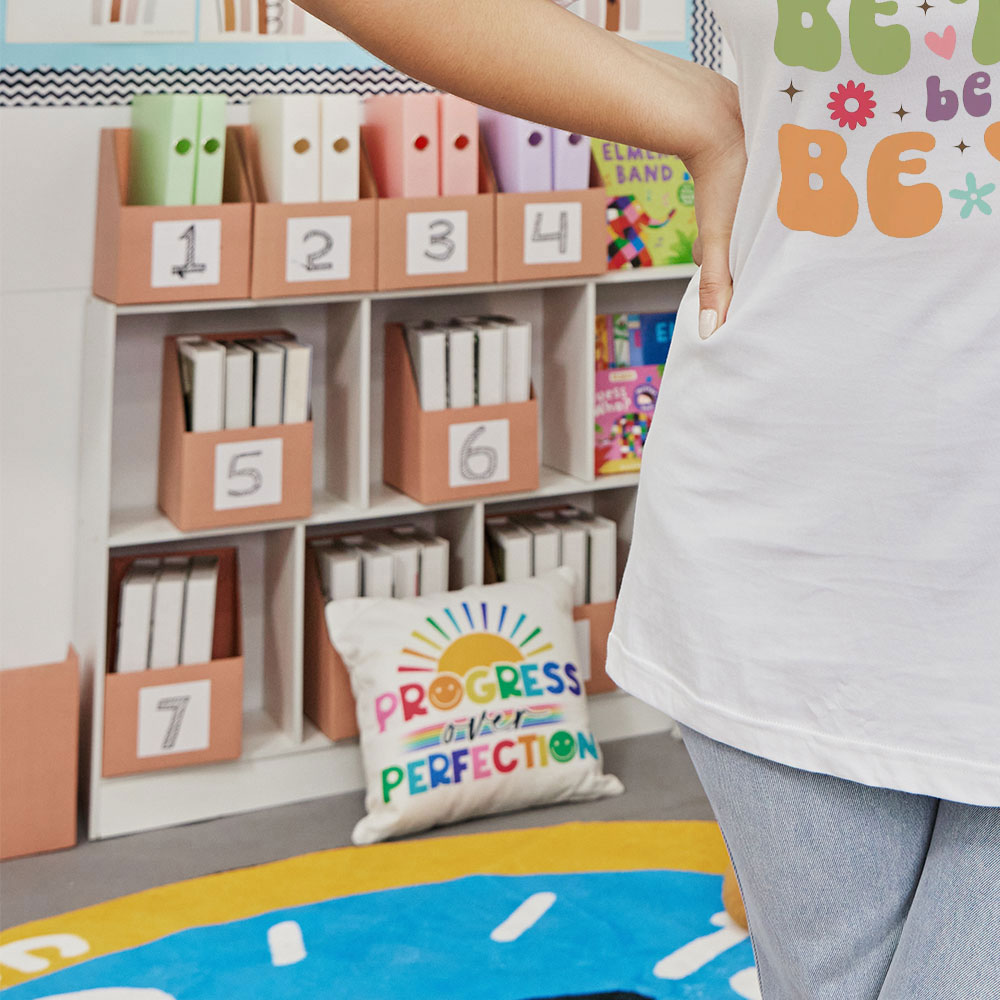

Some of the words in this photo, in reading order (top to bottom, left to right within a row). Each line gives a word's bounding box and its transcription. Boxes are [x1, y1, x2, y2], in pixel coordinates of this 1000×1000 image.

[925, 71, 992, 122] be
[616, 165, 673, 184] BAND
[776, 123, 943, 239] BE
[172, 224, 207, 279] 1
[301, 229, 334, 272] 2
[423, 219, 456, 262] 3
[531, 211, 568, 255] 4
[227, 450, 264, 497] 5
[460, 426, 498, 481] 6
[156, 695, 191, 749] 7
[374, 661, 582, 734] PROGRESS
[442, 710, 532, 744] over
[381, 730, 599, 804] PERFECTION
